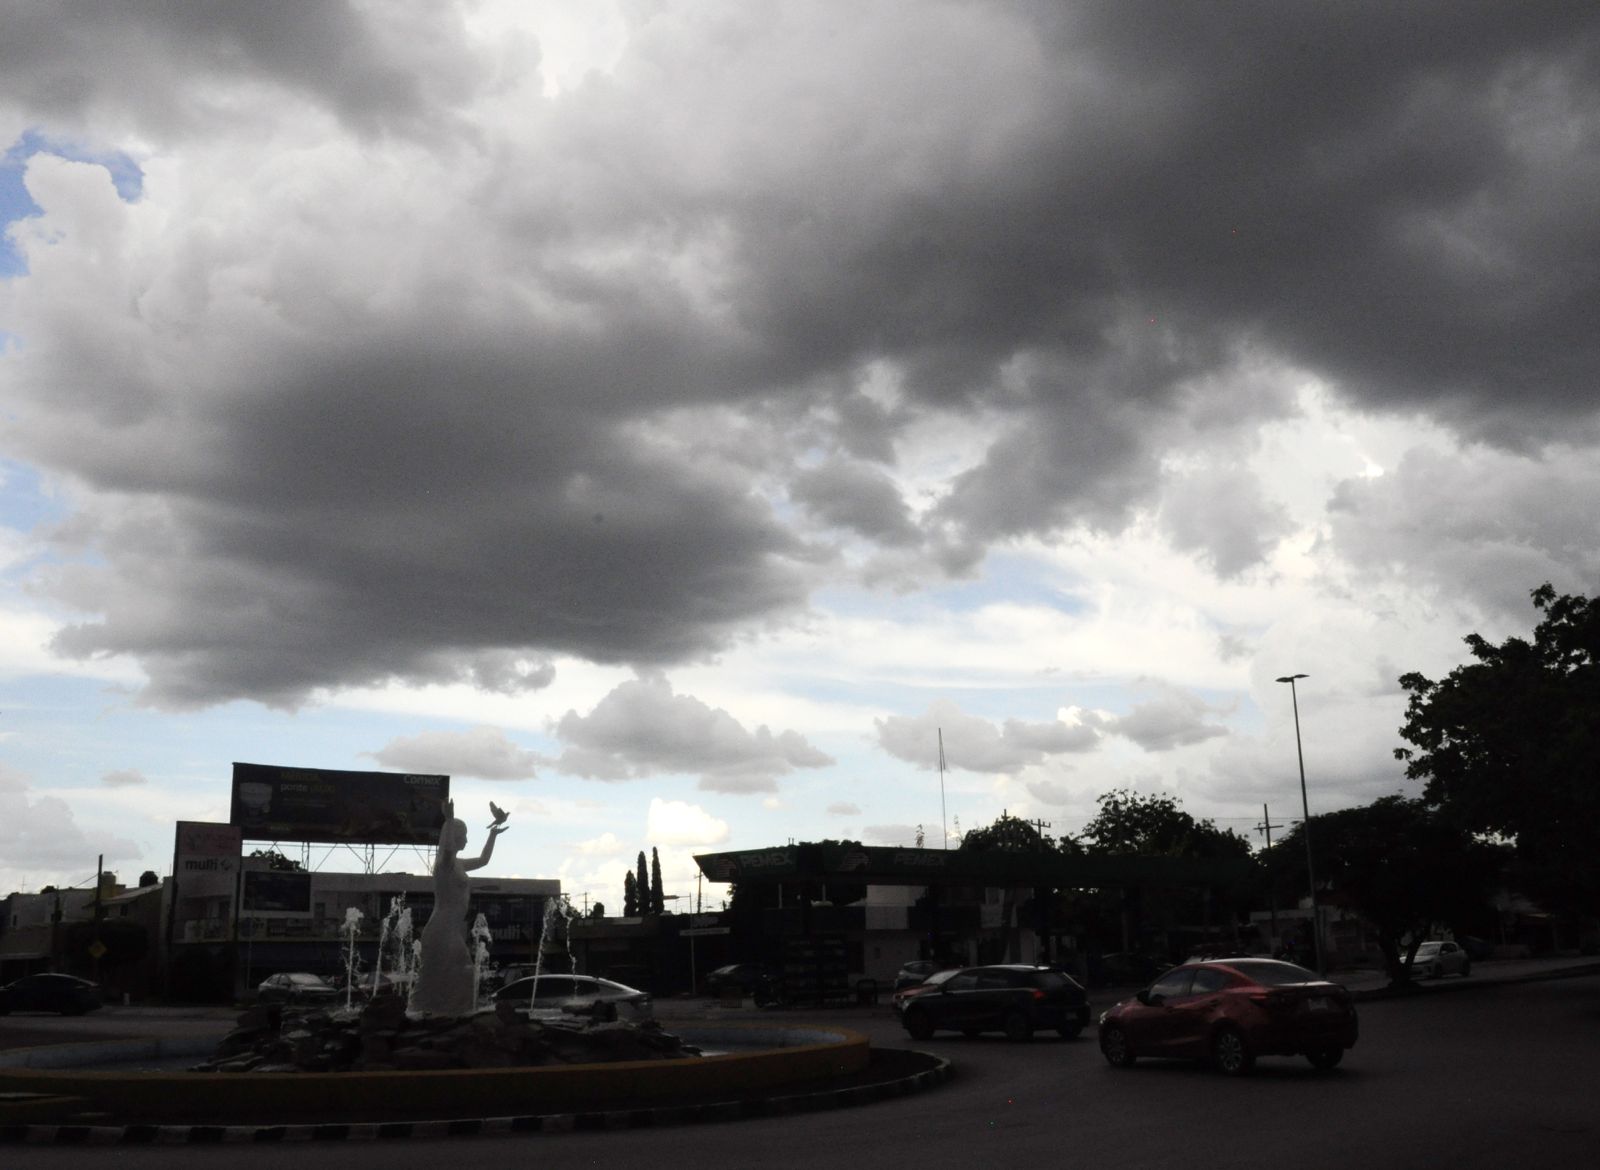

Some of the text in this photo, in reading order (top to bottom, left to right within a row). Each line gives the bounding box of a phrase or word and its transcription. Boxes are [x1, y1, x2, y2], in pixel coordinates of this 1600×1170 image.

[404, 774, 440, 785] Comex
[740, 852, 792, 868] PEMEX
[894, 853, 945, 866] PEMEX
